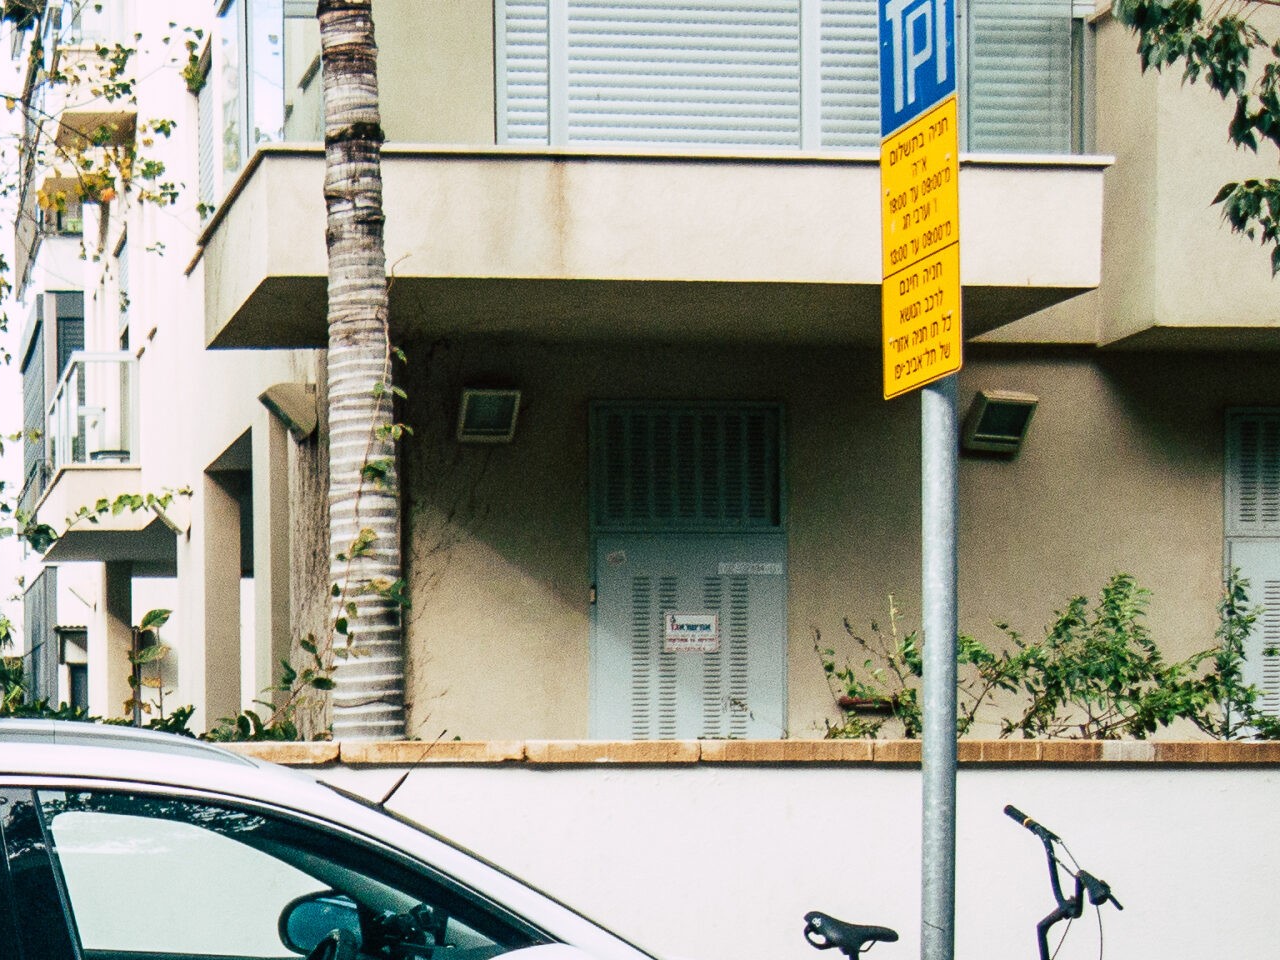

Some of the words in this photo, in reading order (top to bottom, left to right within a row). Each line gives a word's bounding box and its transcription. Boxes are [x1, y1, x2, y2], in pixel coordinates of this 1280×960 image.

[929, 117, 948, 142] חניה
[890, 132, 924, 166] בתשלום
[910, 185, 918, 203] עד
[910, 238, 919, 255] עד
[923, 261, 942, 284] חניה
[900, 273, 918, 296] חינם
[925, 286, 943, 313] לרכב
[900, 300, 921, 324] הנושא
[942, 312, 952, 332] כל
[912, 326, 927, 345] חניה
[931, 321, 939, 338] תו
[939, 341, 951, 360] של
